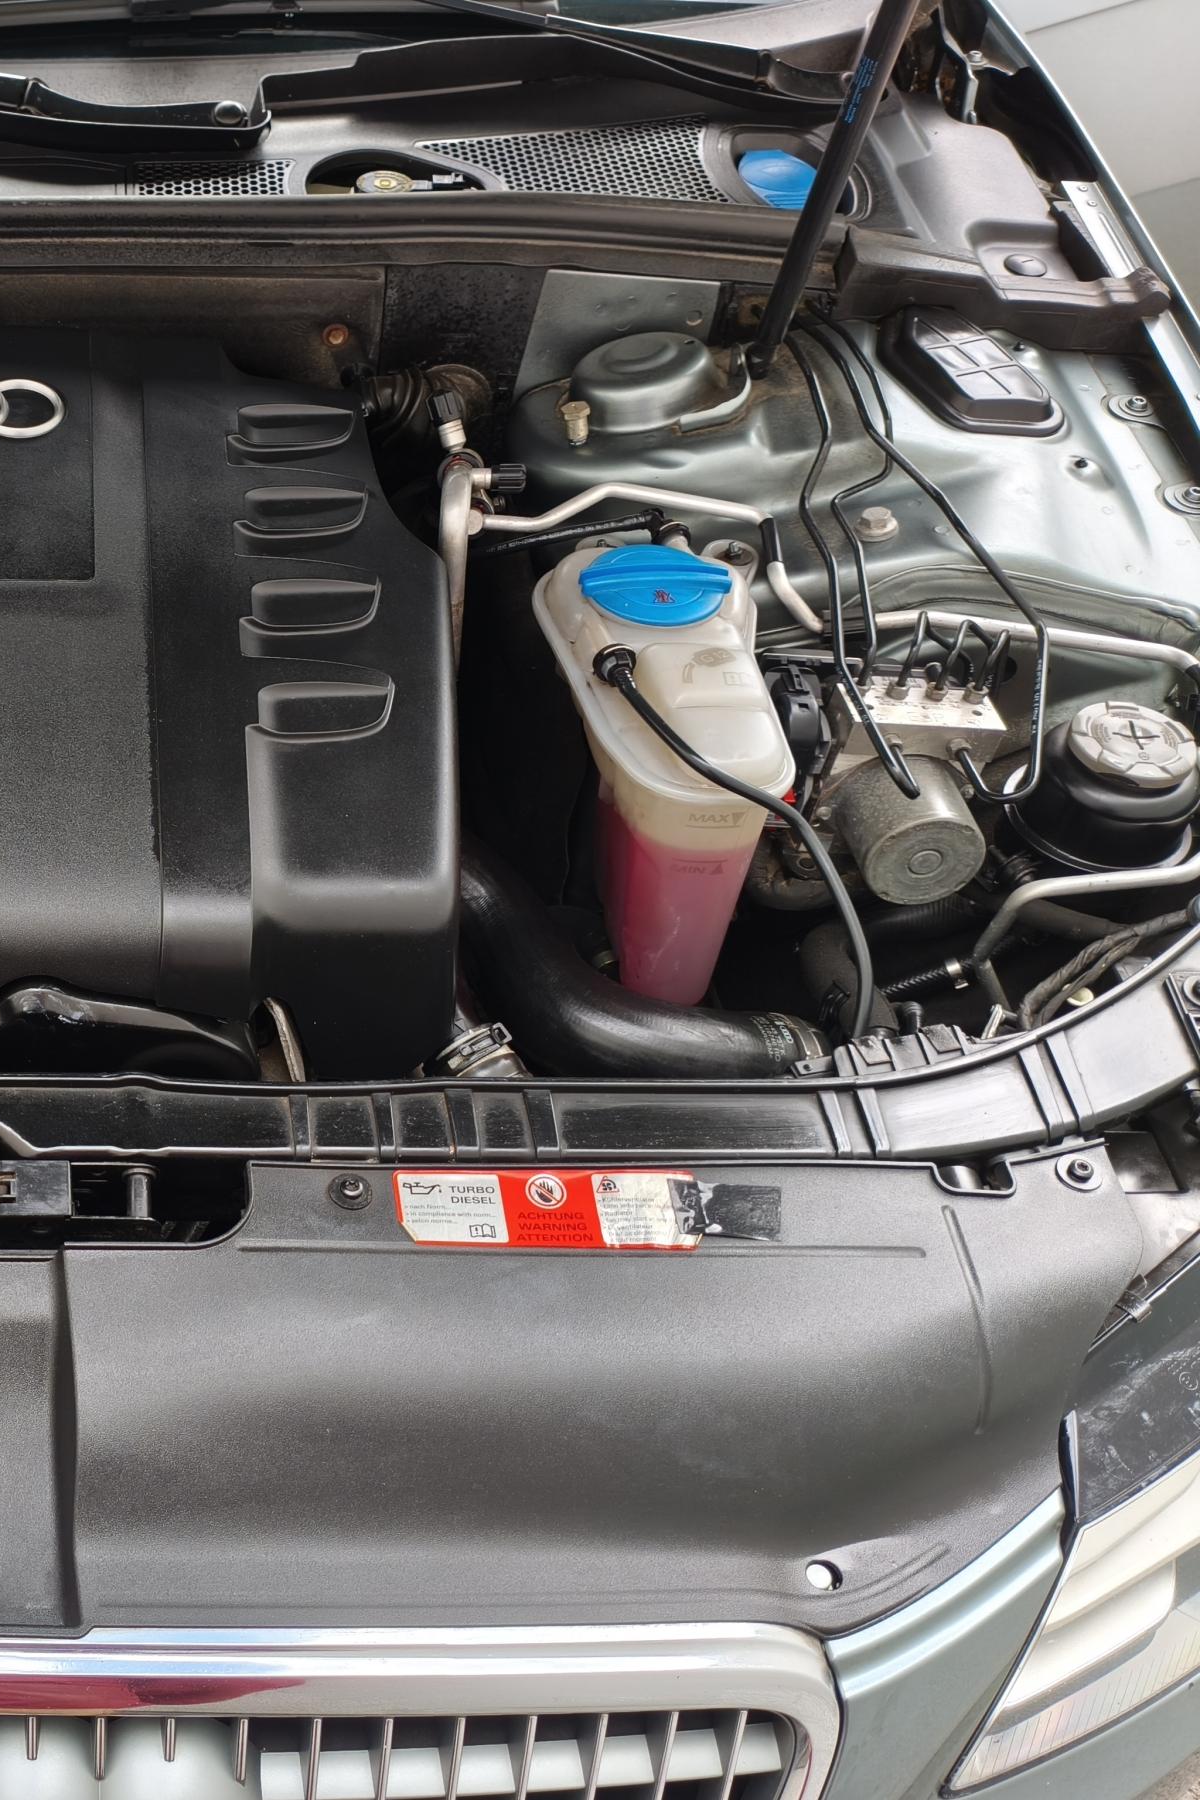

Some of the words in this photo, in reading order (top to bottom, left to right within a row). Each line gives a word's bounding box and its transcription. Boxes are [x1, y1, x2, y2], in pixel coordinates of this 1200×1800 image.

[688, 813, 730, 823] MAX
[448, 1186, 495, 1194] TURBO
[450, 1196, 496, 1205] DIESEL
[518, 1212, 585, 1220] ACHTUNG
[518, 1222, 588, 1231] WARNING
[516, 1233, 594, 1242] ATTENTION
